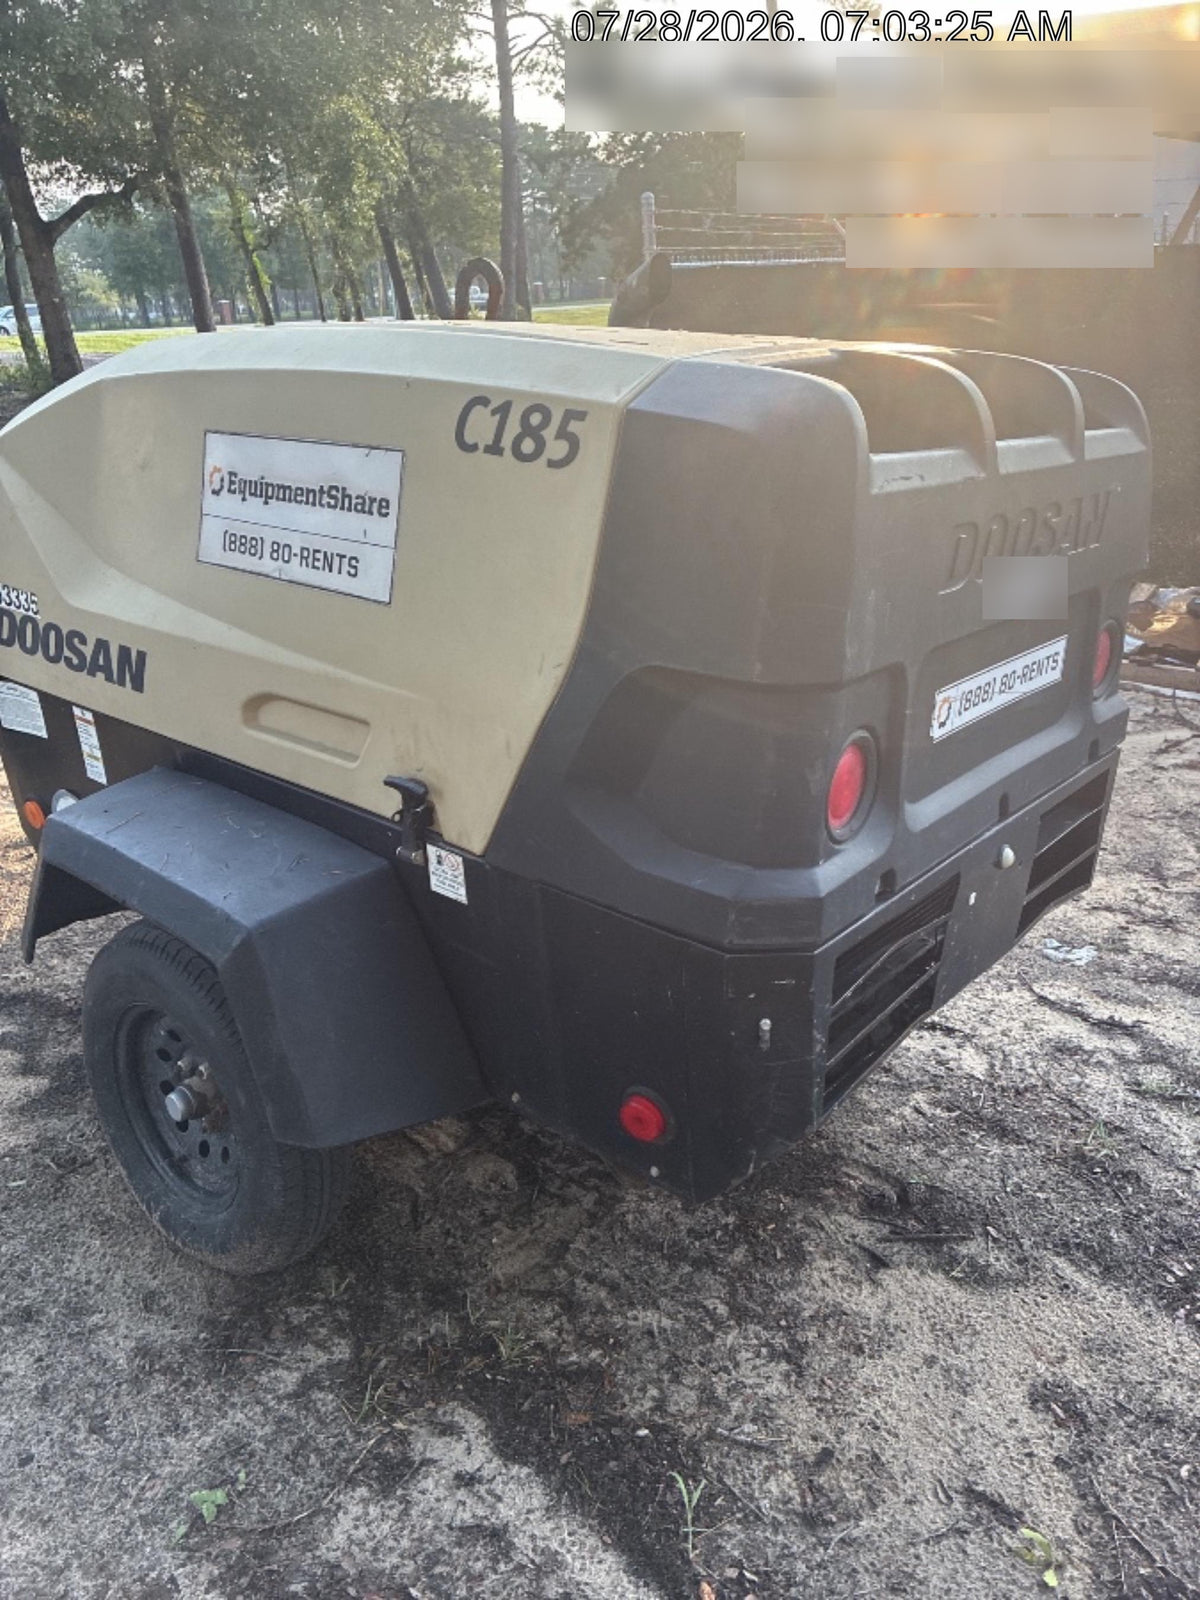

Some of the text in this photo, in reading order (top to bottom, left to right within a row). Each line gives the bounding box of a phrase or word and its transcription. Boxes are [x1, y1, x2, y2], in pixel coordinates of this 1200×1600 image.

[454, 395, 589, 470] C185
[226, 470, 391, 518] EquipmentShare
[222, 529, 360, 579] (888) 80-RENTS
[0, 584, 40, 615] 3335
[0, 609, 147, 694] DOOSAN
[957, 651, 1061, 716] (888) 80-RENTS
